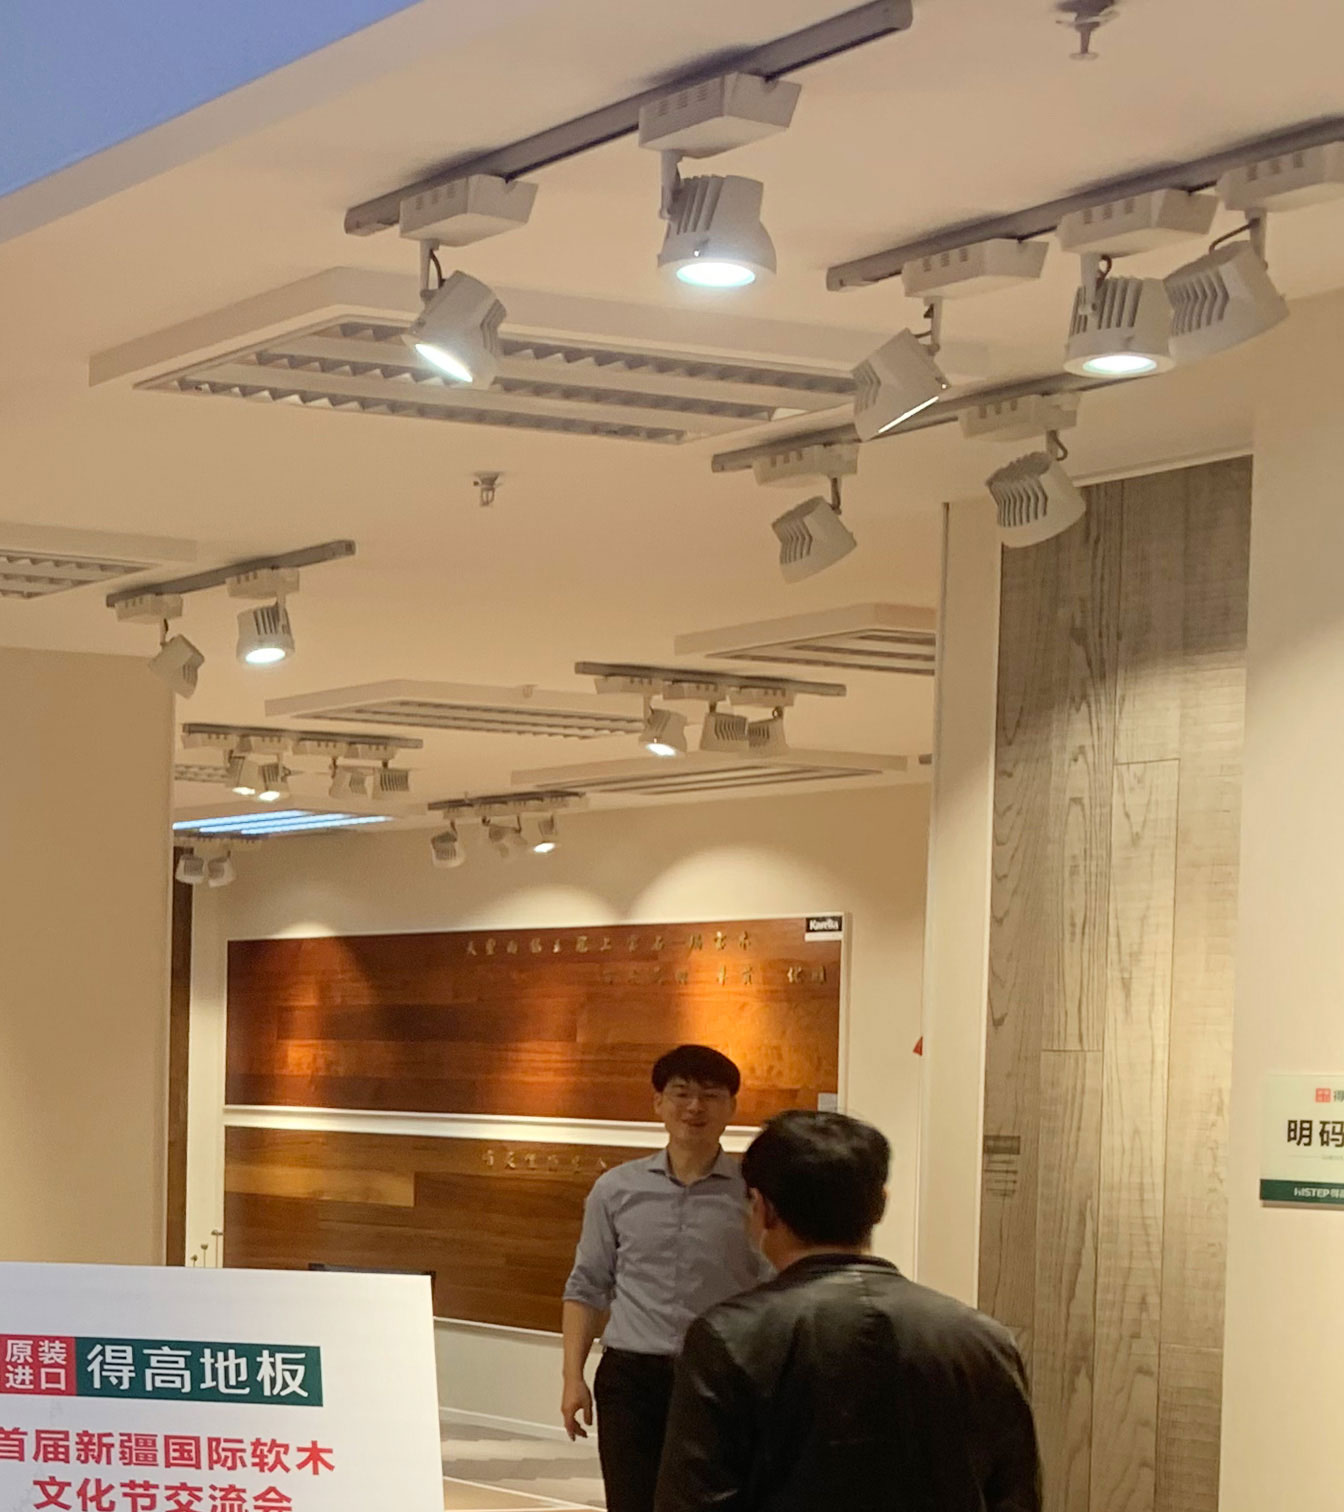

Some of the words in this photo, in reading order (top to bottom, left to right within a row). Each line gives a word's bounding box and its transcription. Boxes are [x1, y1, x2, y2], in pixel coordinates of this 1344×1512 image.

[3, 1365, 68, 1393] 进口
[4, 1338, 68, 1366] 原装
[85, 1343, 310, 1399] 得高地板
